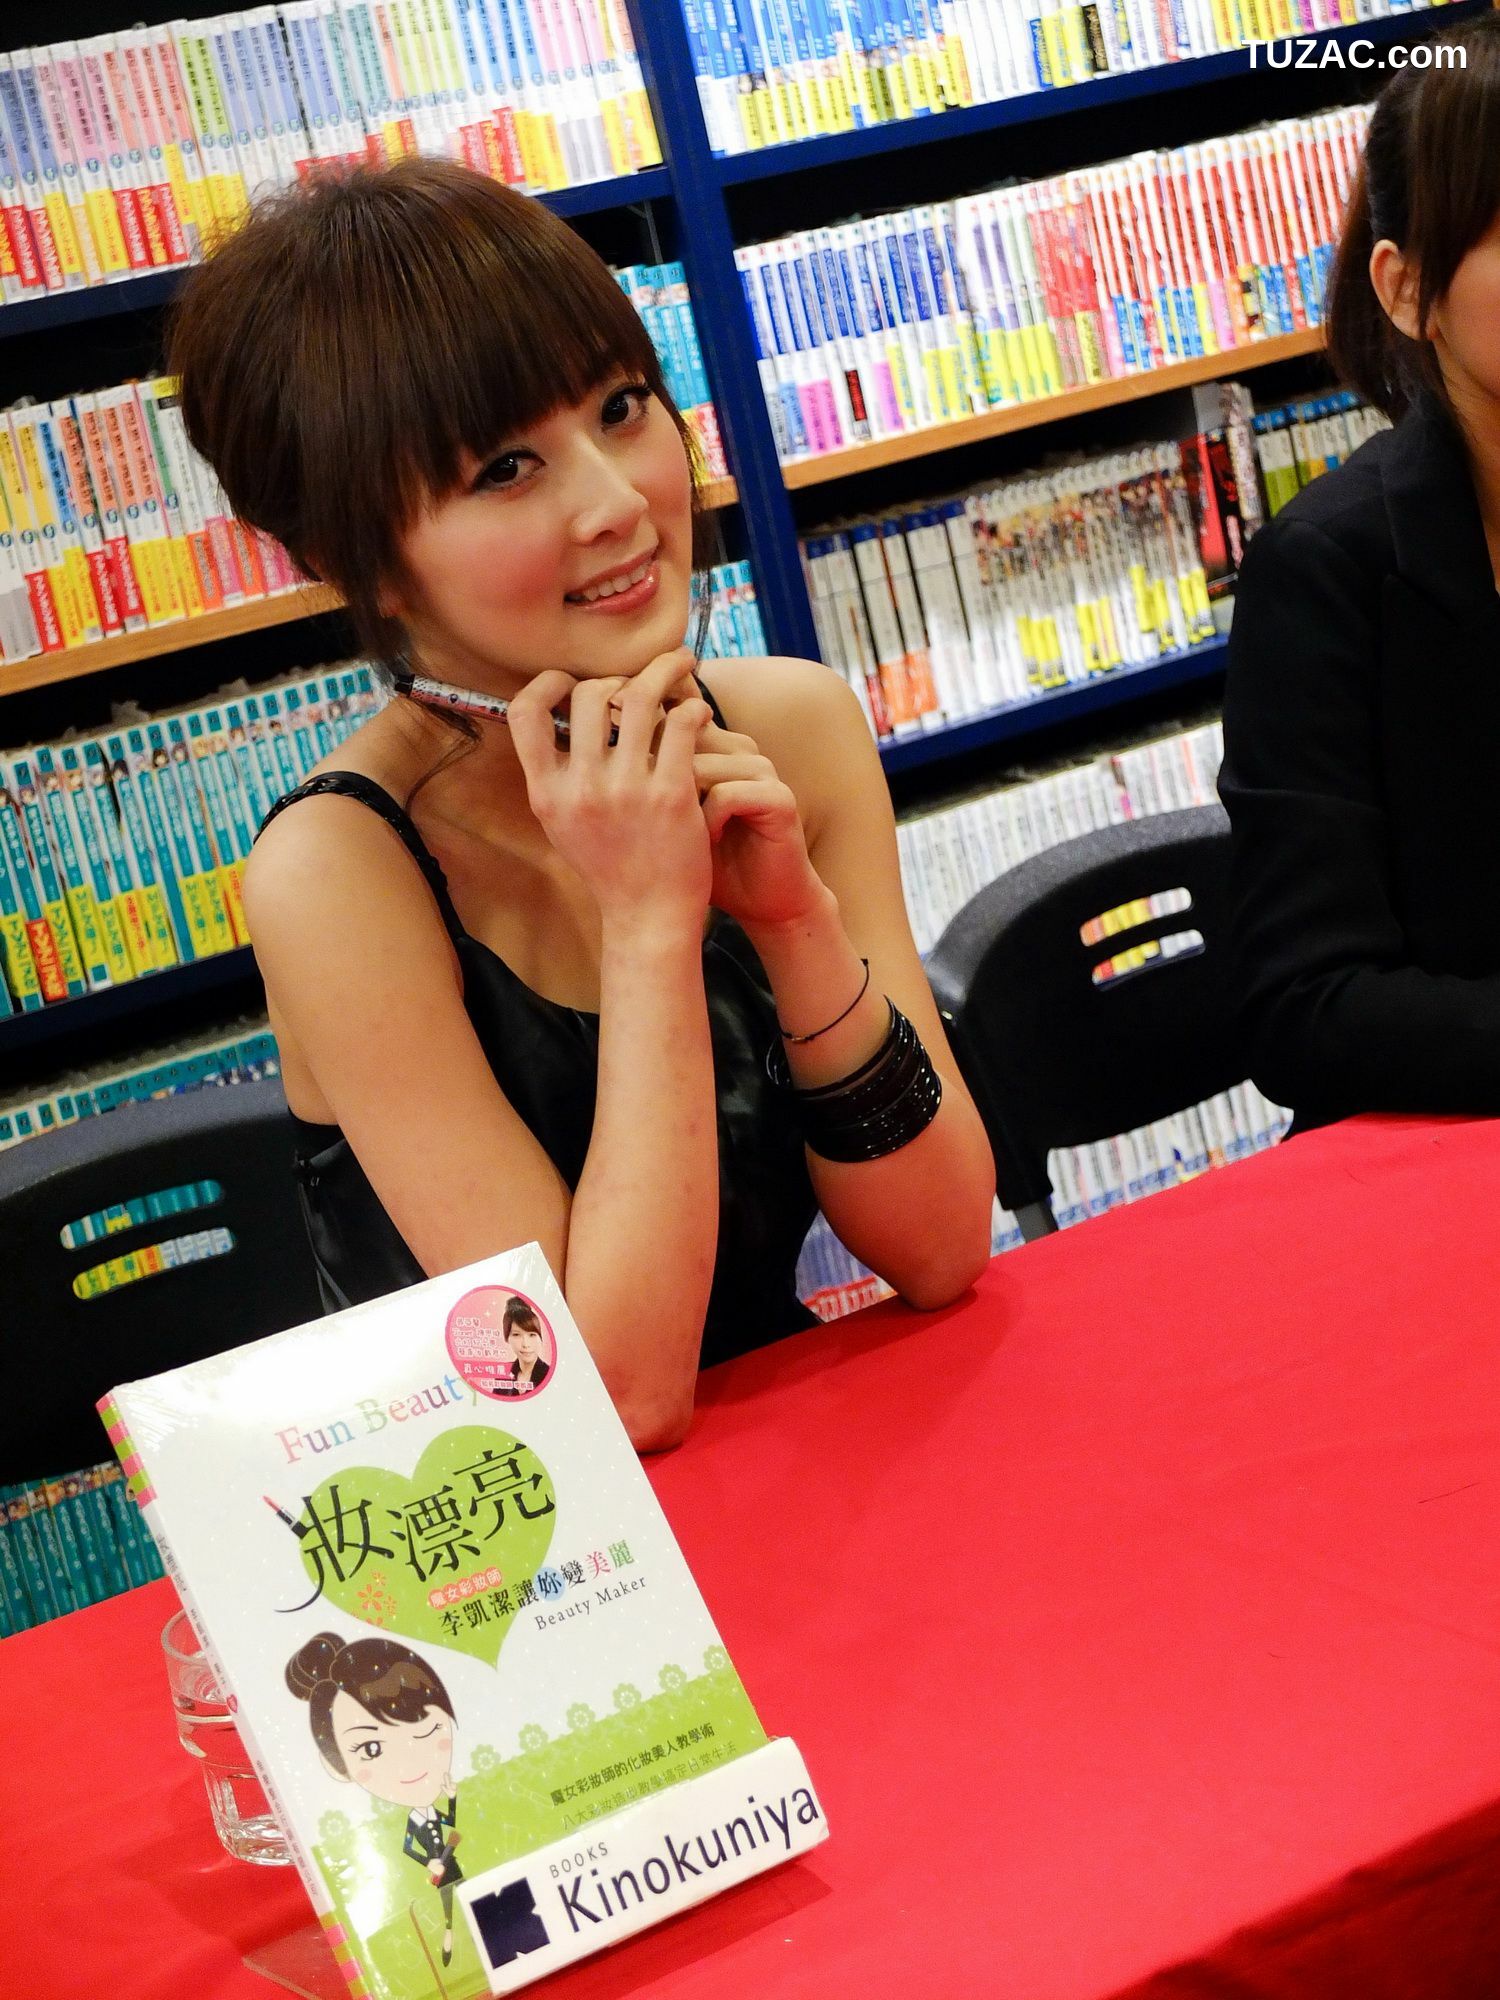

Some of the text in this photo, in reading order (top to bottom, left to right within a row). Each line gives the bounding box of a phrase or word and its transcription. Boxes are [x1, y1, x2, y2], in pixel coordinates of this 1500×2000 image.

[275, 1420, 355, 1464] Fun
[274, 1443, 555, 1613] 妝漂亮
[534, 1576, 647, 1631] Beauty Maker
[549, 1842, 609, 1879] BOOKS
[557, 1787, 820, 1934] Kinokuniya
